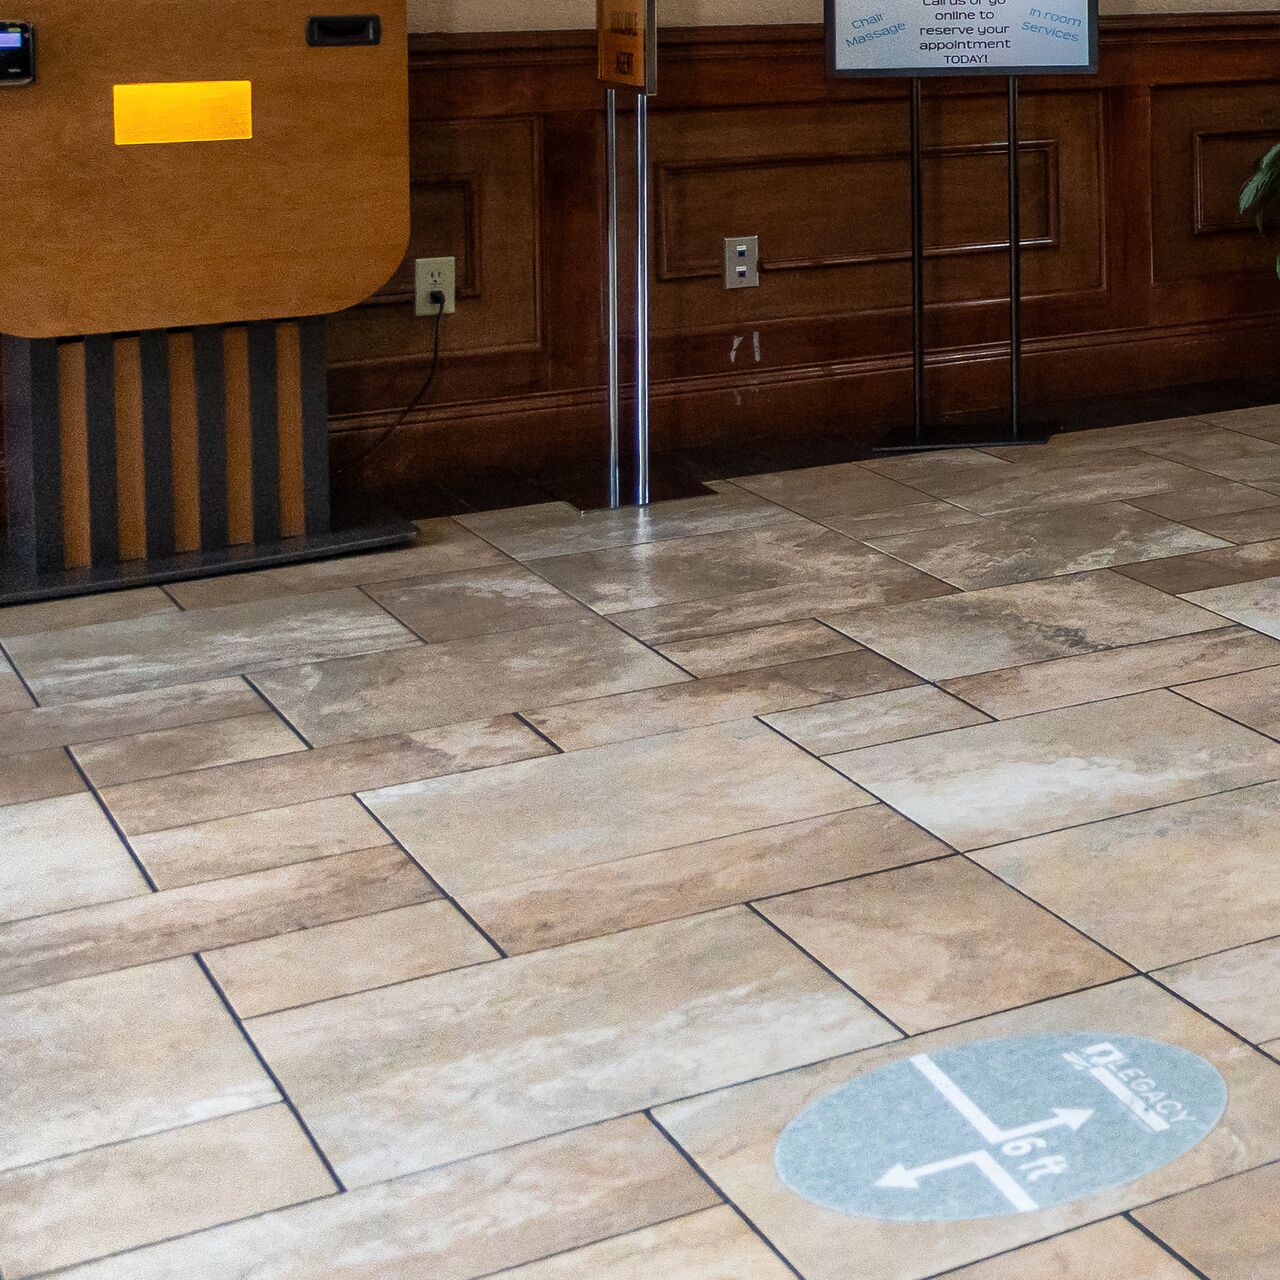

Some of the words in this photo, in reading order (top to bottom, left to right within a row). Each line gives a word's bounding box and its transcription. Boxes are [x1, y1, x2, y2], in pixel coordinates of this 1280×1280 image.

[851, 11, 886, 30] Chair
[935, 10, 974, 20] online
[979, 10, 995, 20] to
[1043, 11, 1082, 27] room
[845, 21, 907, 49] Massage
[919, 26, 974, 36] reserve
[977, 25, 1011, 37] your
[919, 39, 1011, 52] appointment
[943, 54, 988, 64] TODAY!
[1108, 1059, 1197, 1123] LEGACY
[1001, 1136, 1047, 1157] 6
[1019, 1154, 1069, 1183] ft
